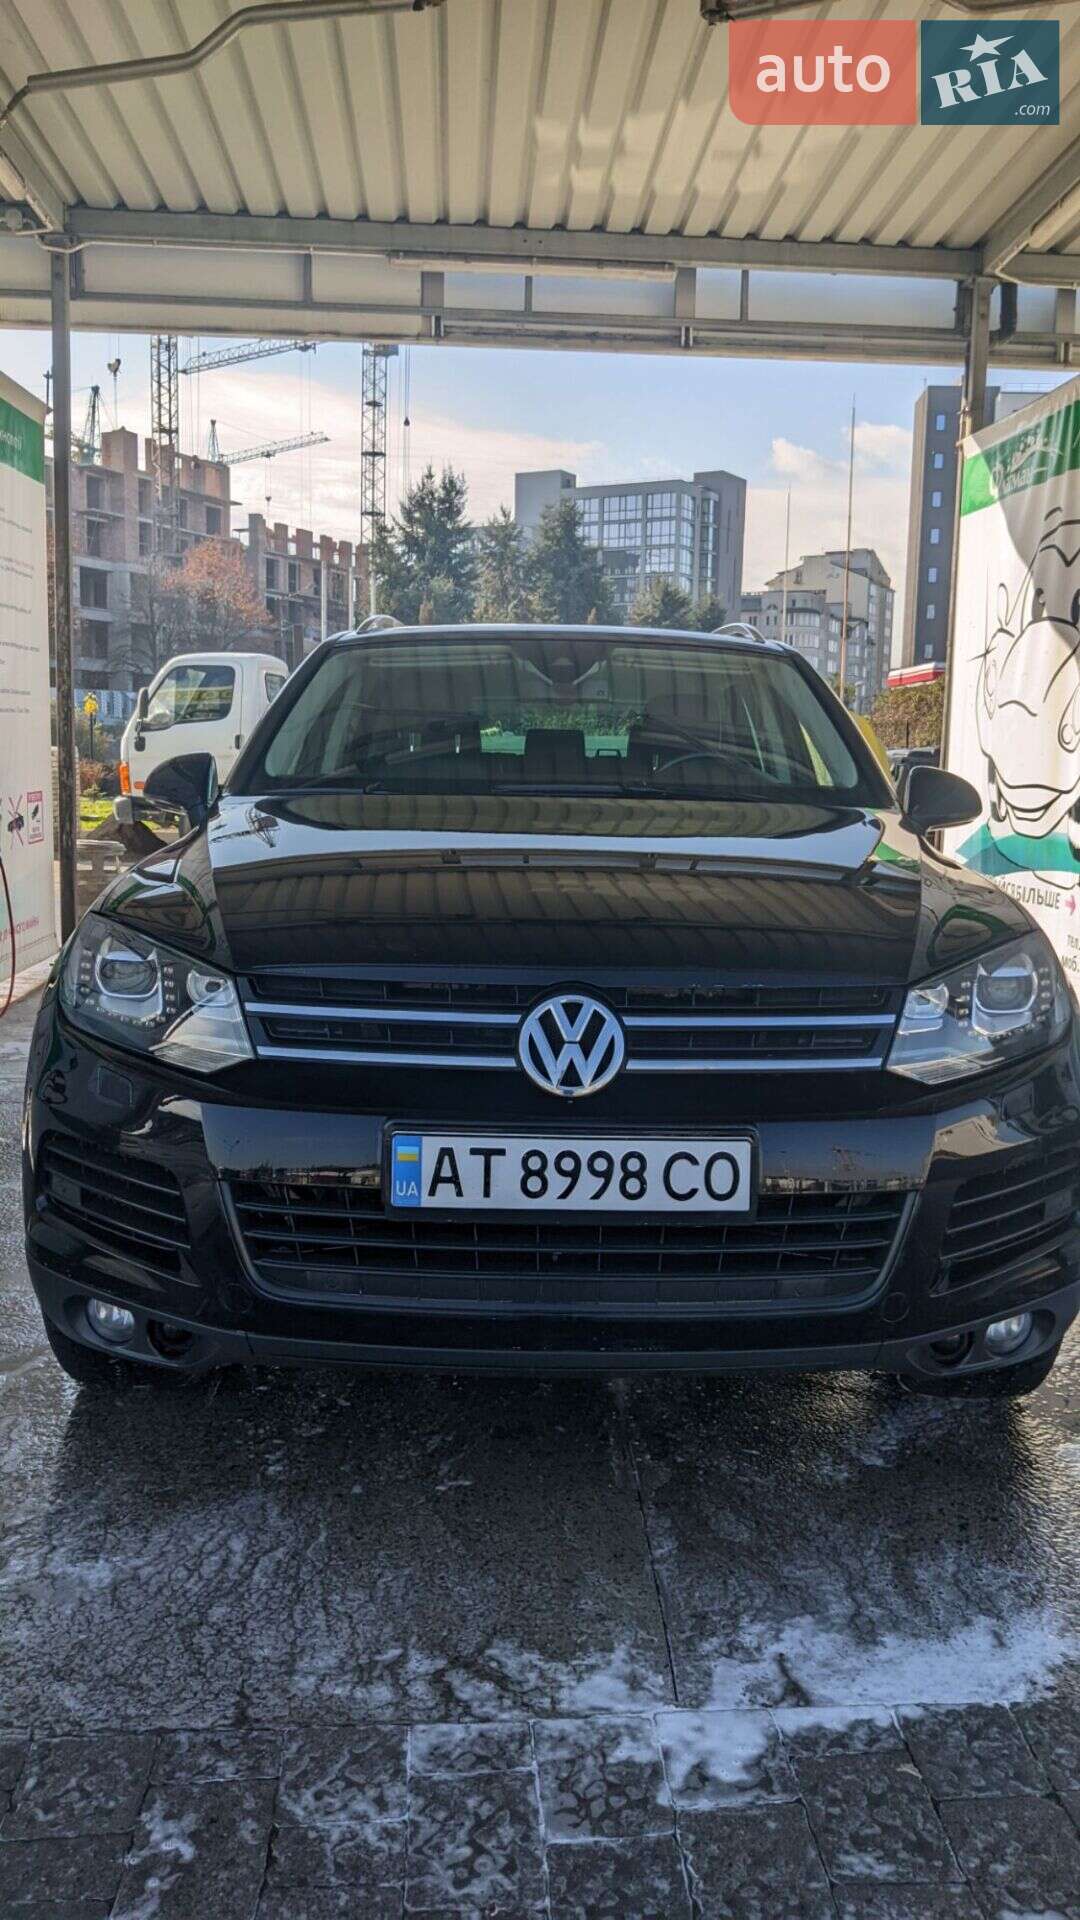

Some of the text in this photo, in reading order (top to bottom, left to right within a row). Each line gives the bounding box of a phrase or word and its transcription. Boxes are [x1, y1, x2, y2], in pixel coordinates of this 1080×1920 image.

[396, 1146, 740, 1202] UA AT 8998 CO
